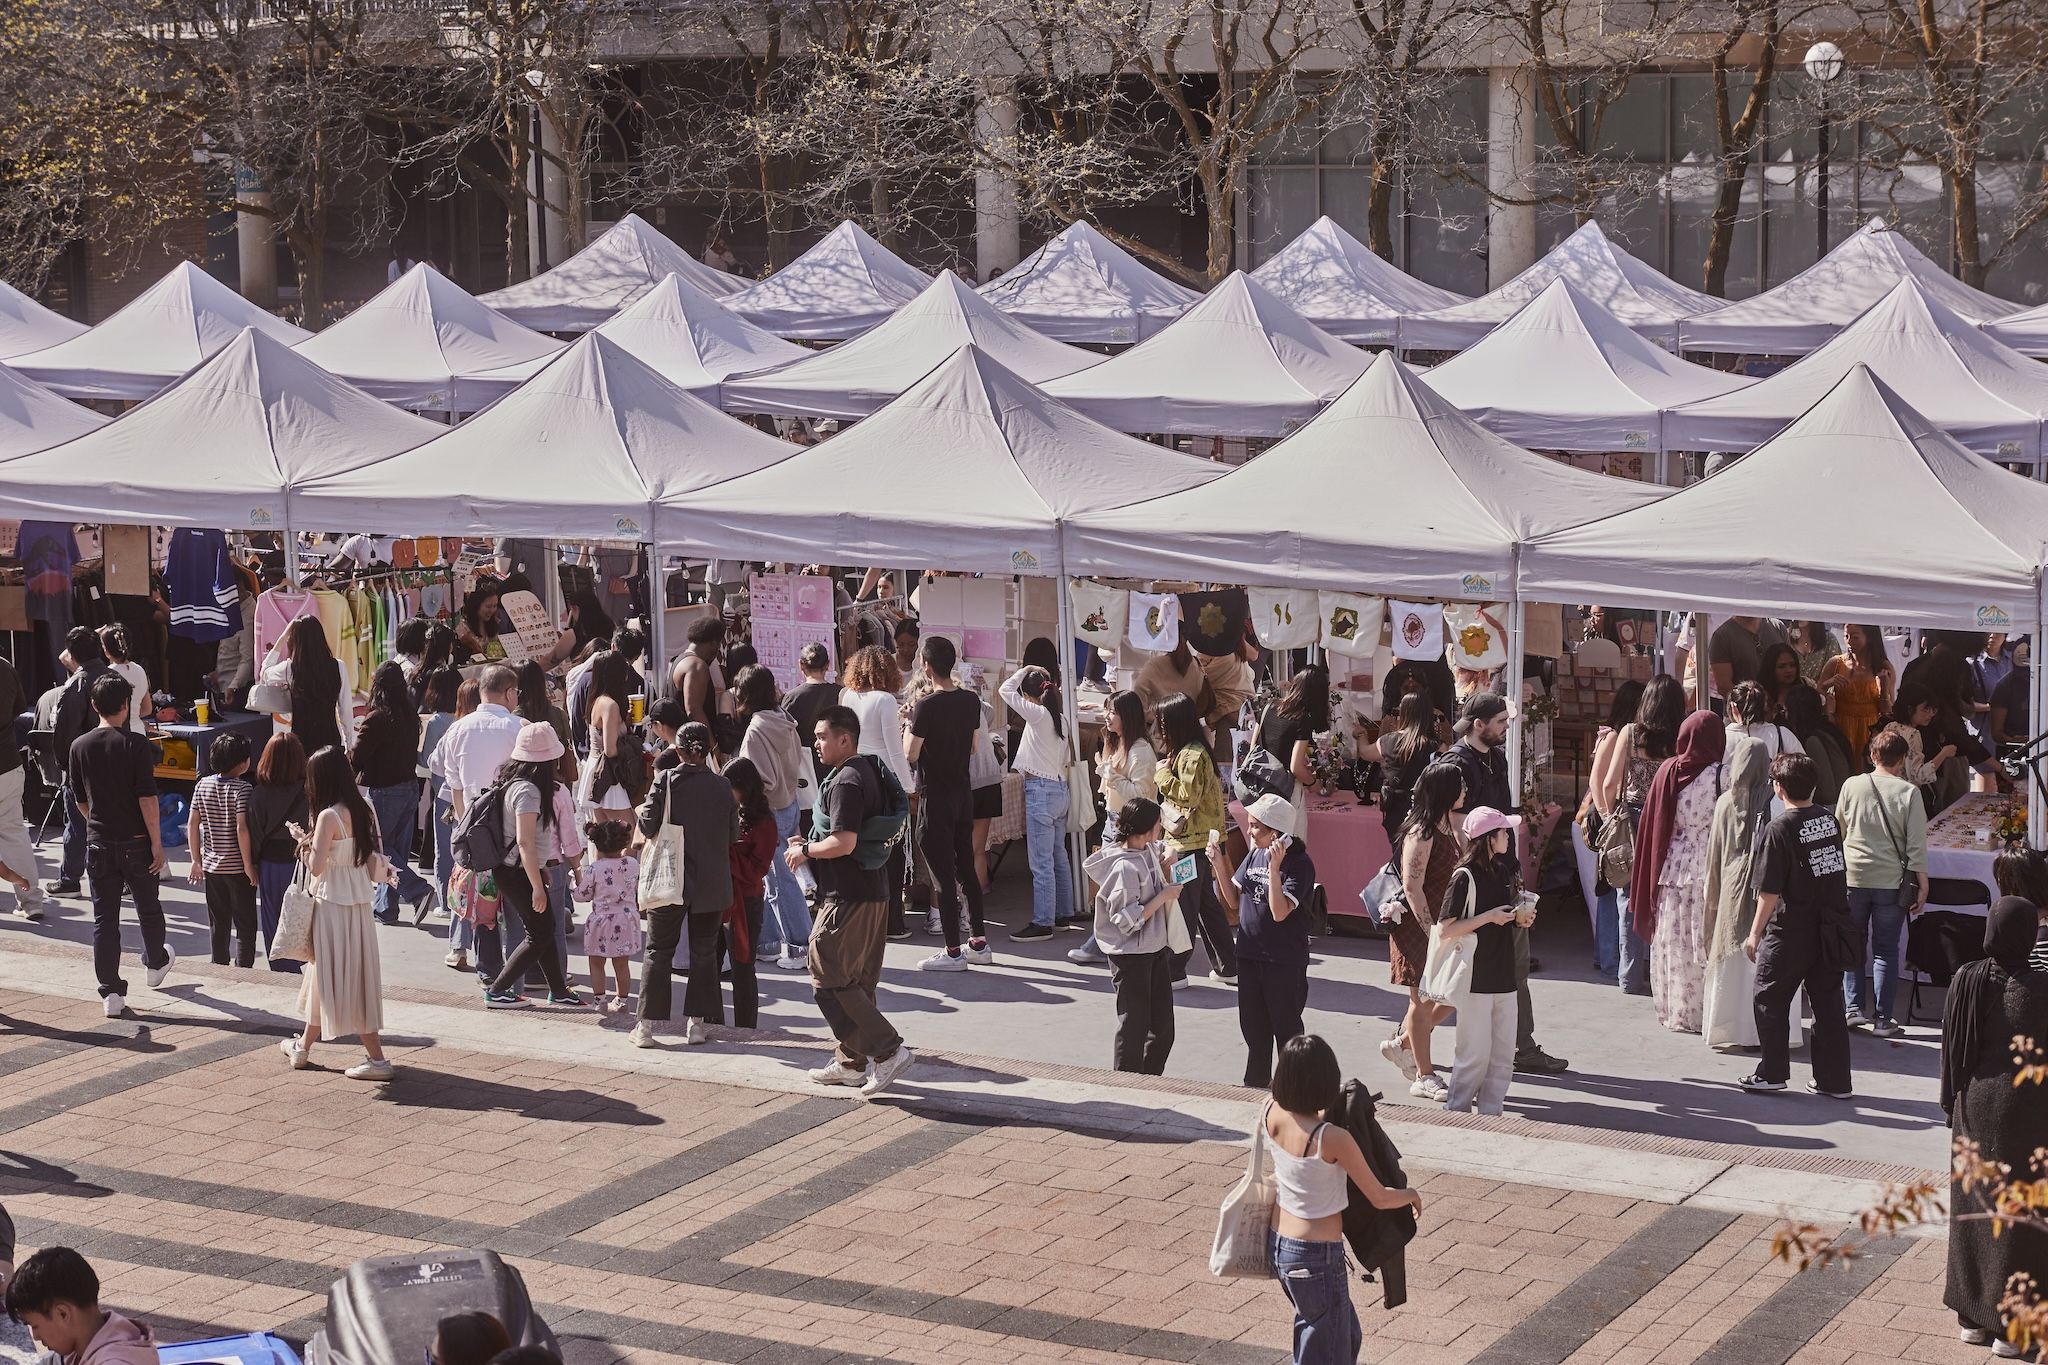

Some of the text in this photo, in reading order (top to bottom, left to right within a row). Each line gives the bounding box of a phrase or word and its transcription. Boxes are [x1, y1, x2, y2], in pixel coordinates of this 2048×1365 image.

[1977, 606, 2008, 626] Sunshine
[1799, 821, 1835, 836] CLOUDS
[1803, 819, 1816, 828] LOST
[432, 1274, 462, 1283] LITTER
